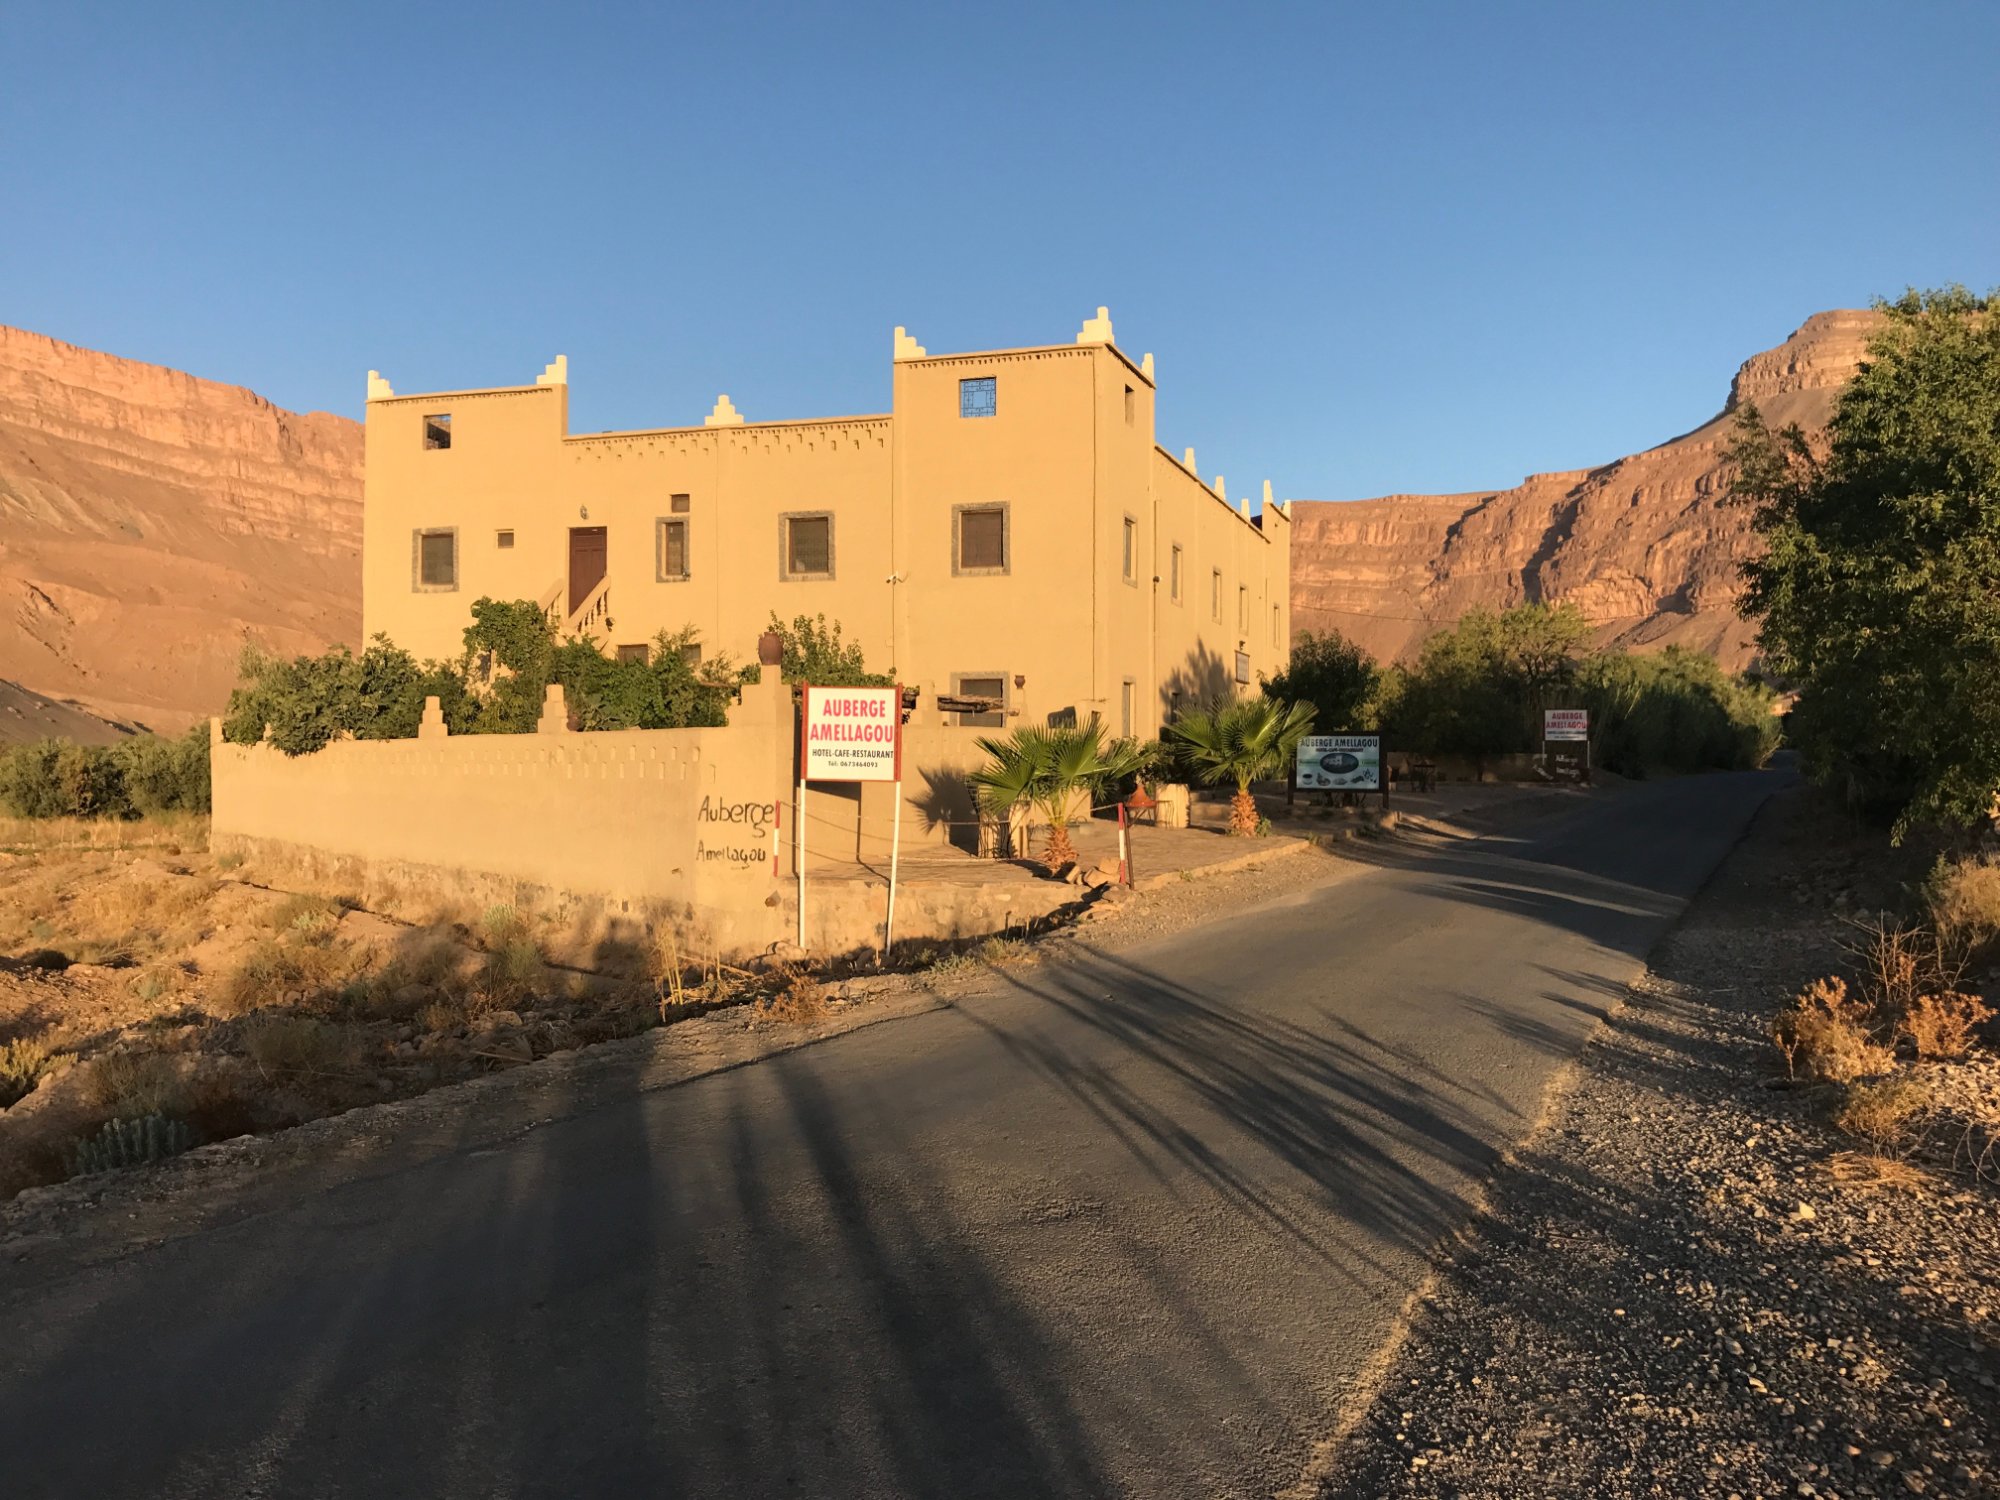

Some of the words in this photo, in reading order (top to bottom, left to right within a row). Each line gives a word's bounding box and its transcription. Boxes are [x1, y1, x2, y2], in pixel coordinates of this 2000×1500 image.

[823, 699, 886, 718] AUBERGE
[810, 723, 893, 743] AMELLAGOU
[1301, 738, 1332, 747] AUBERGE
[1334, 738, 1378, 747] AMELLAGOU
[812, 749, 893, 759] HOTEL-CAFE-RESTAURANT
[698, 794, 774, 838] Auberge
